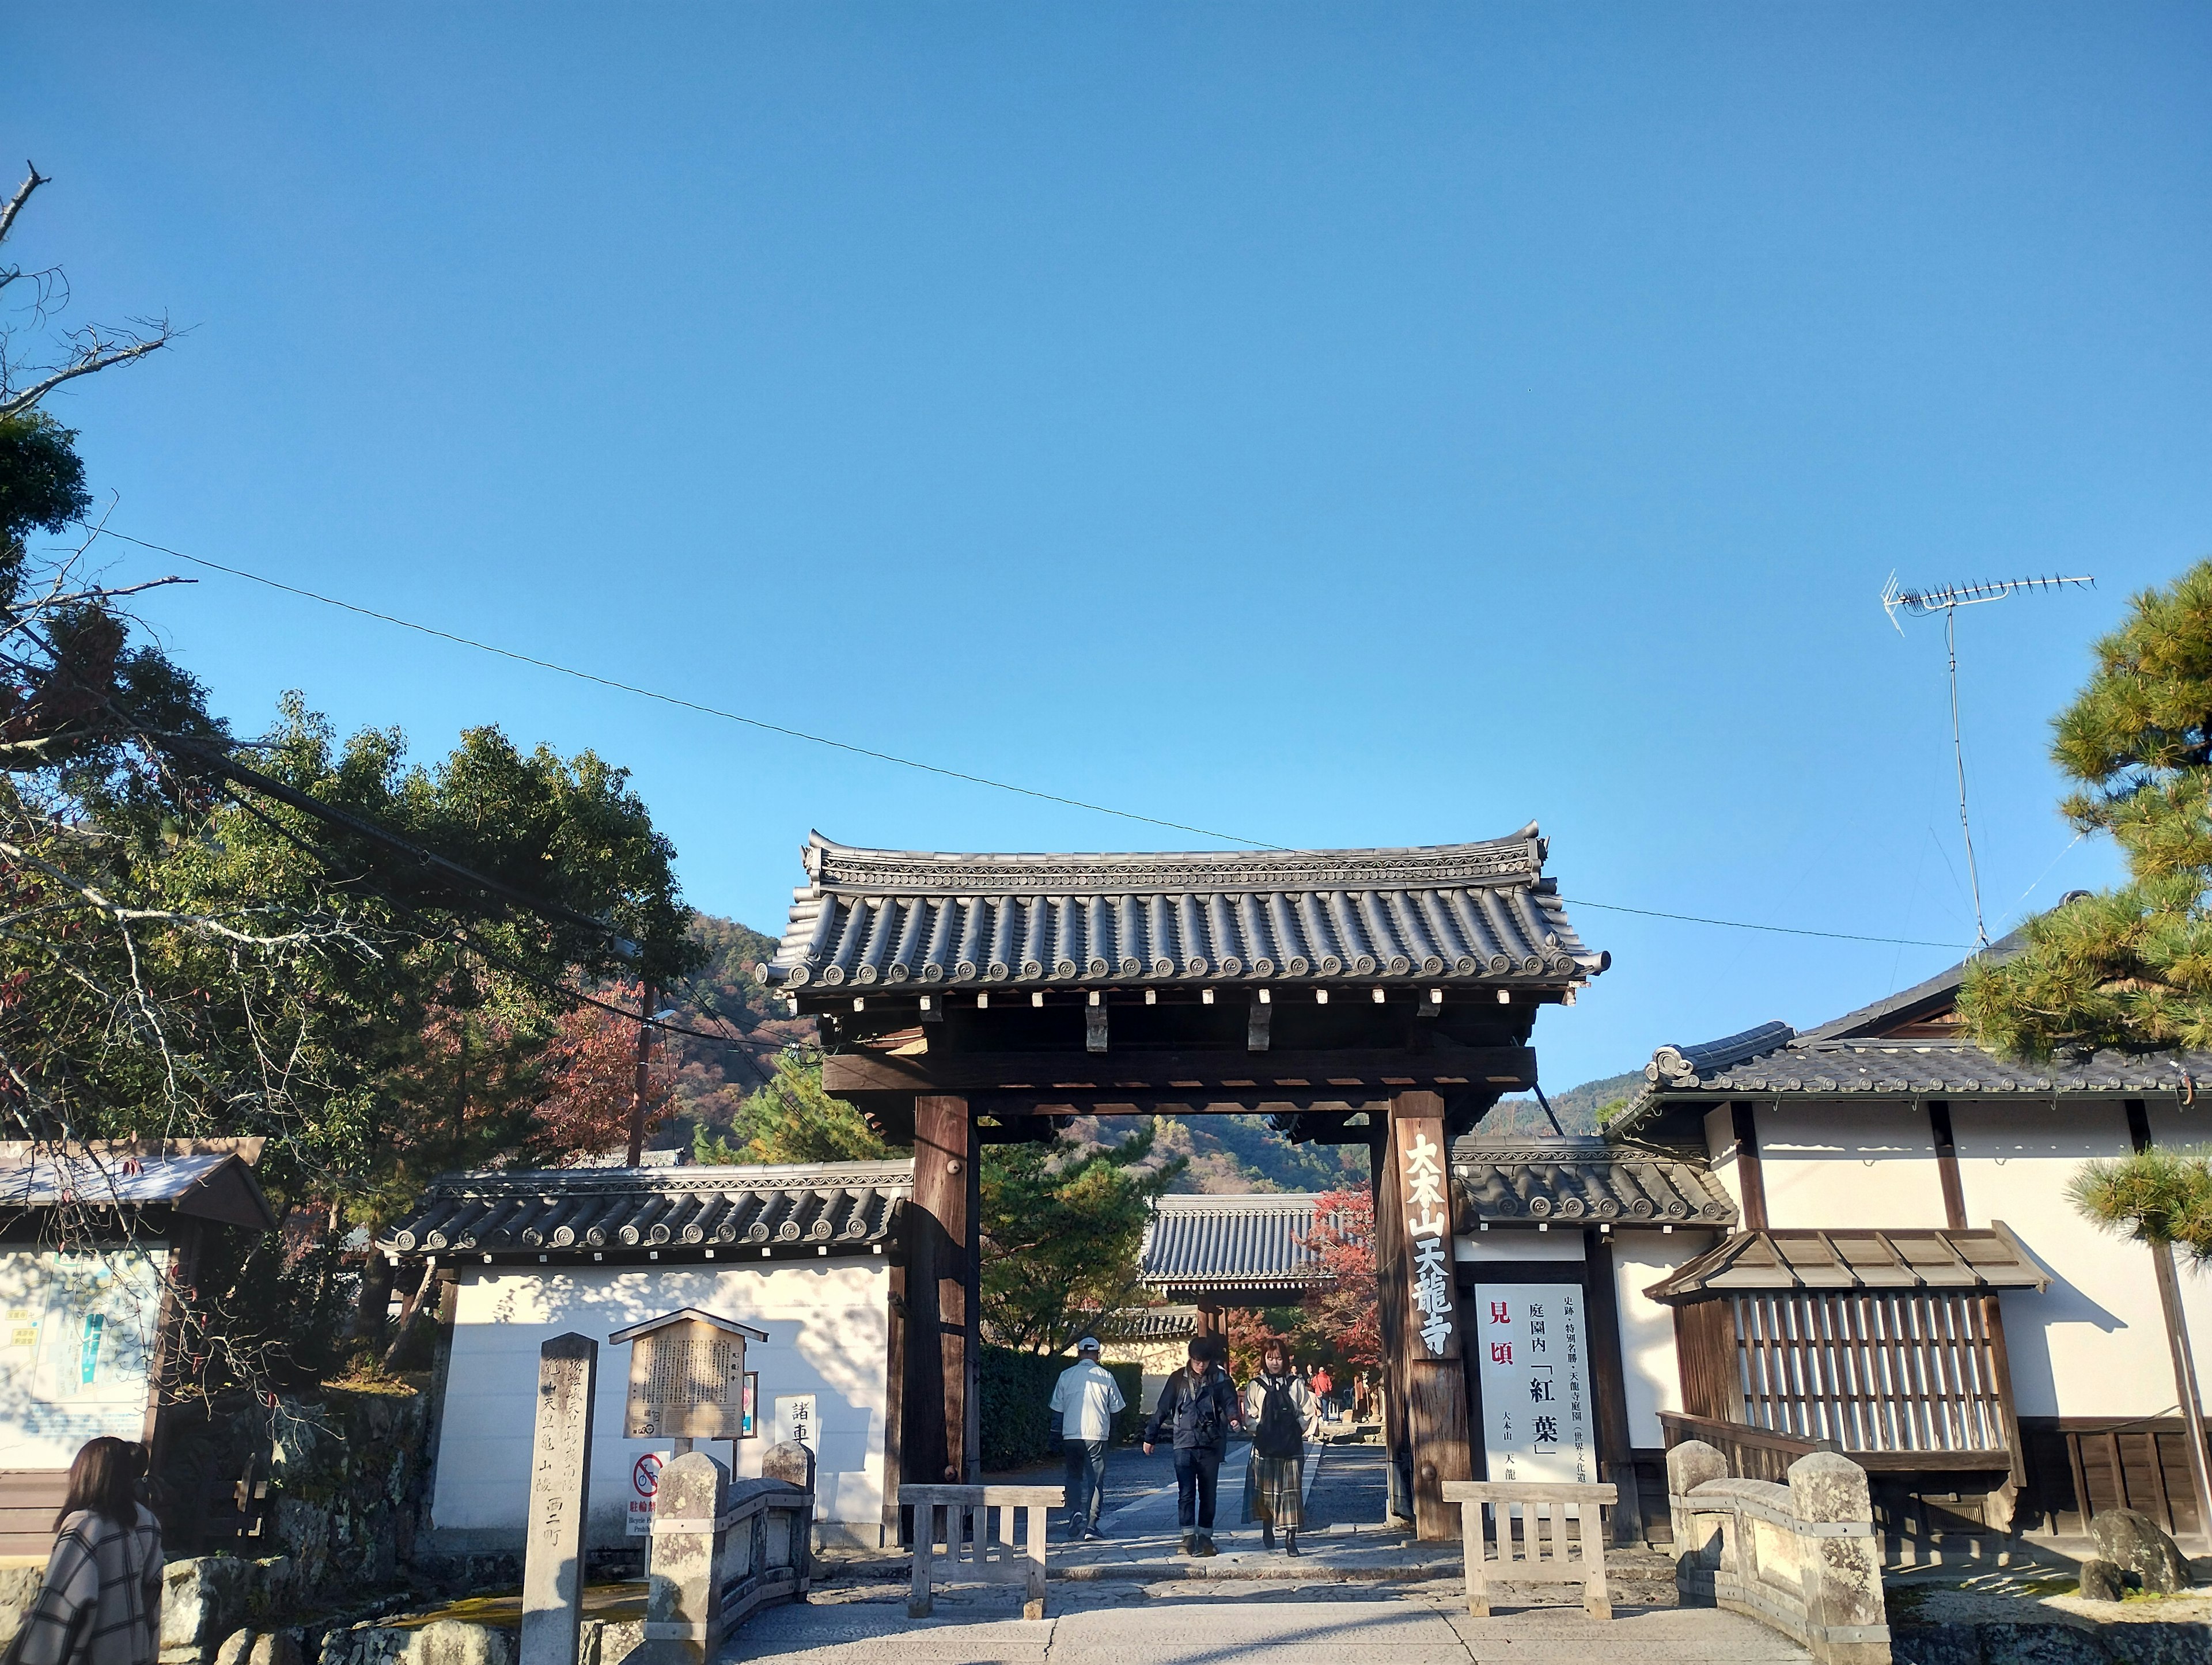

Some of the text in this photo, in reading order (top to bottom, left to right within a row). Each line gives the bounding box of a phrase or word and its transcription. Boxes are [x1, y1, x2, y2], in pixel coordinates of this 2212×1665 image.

[1404, 1133, 1452, 1355] 大本山天龍寺
[1488, 1300, 1514, 1366] 見頃
